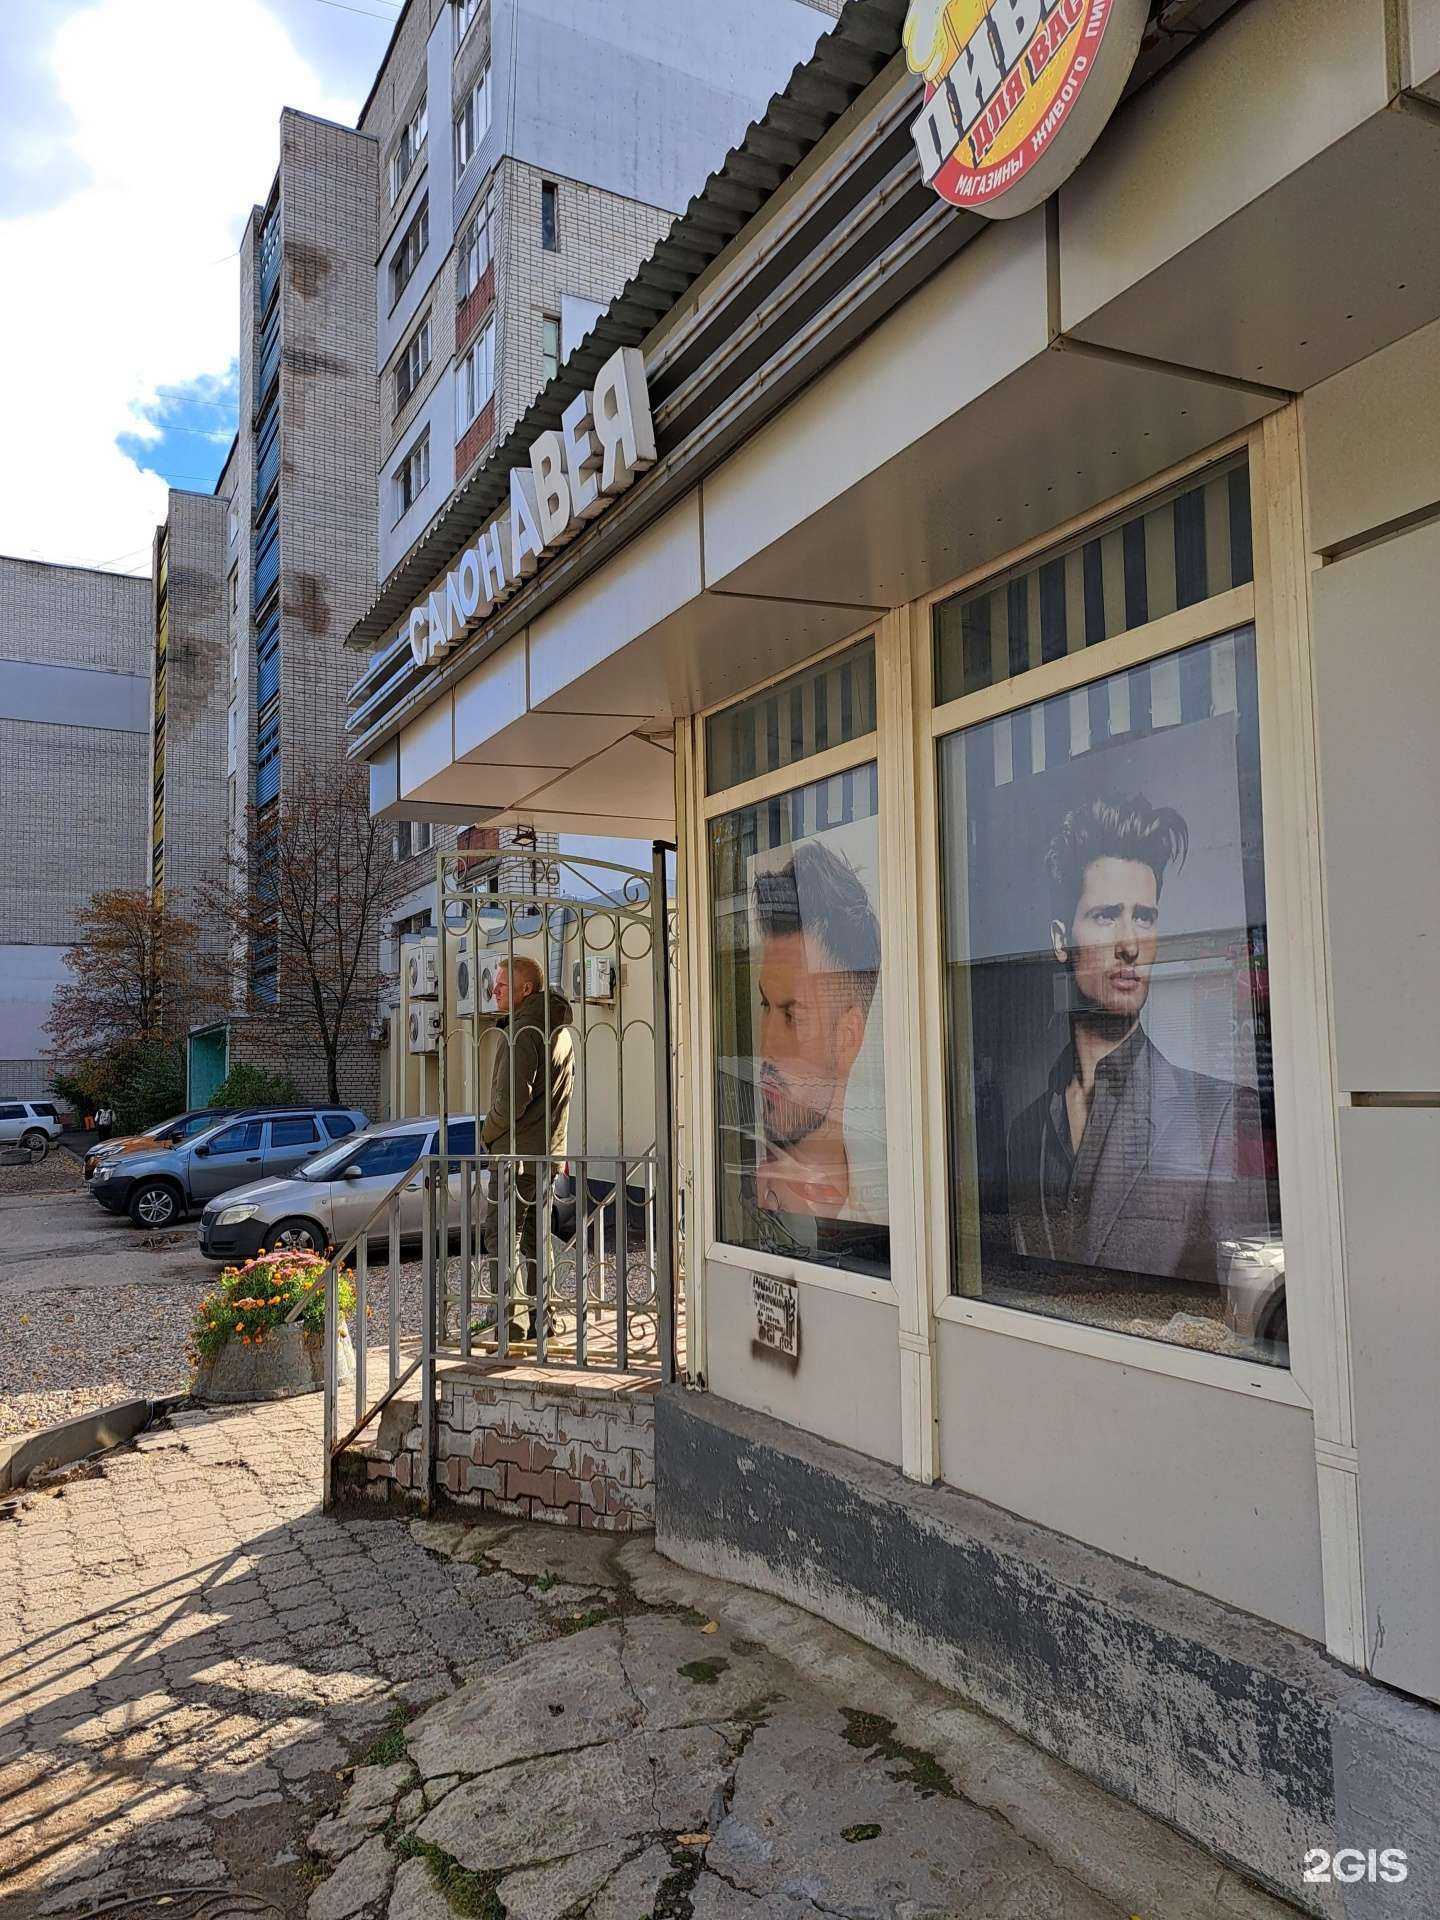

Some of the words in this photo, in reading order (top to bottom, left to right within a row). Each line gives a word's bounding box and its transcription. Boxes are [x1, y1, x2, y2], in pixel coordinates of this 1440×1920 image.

[910, 0, 1059, 184] ПИВ
[955, 151, 1024, 195] МАГАЗИНЫ
[1031, 55, 1088, 152] ЖИВОГО
[970, 67, 1027, 163] ДЛЯ
[1027, 0, 1085, 80] ВАС
[409, 520, 513, 667] САЛОН
[510, 346, 657, 578] АВЕЯ
